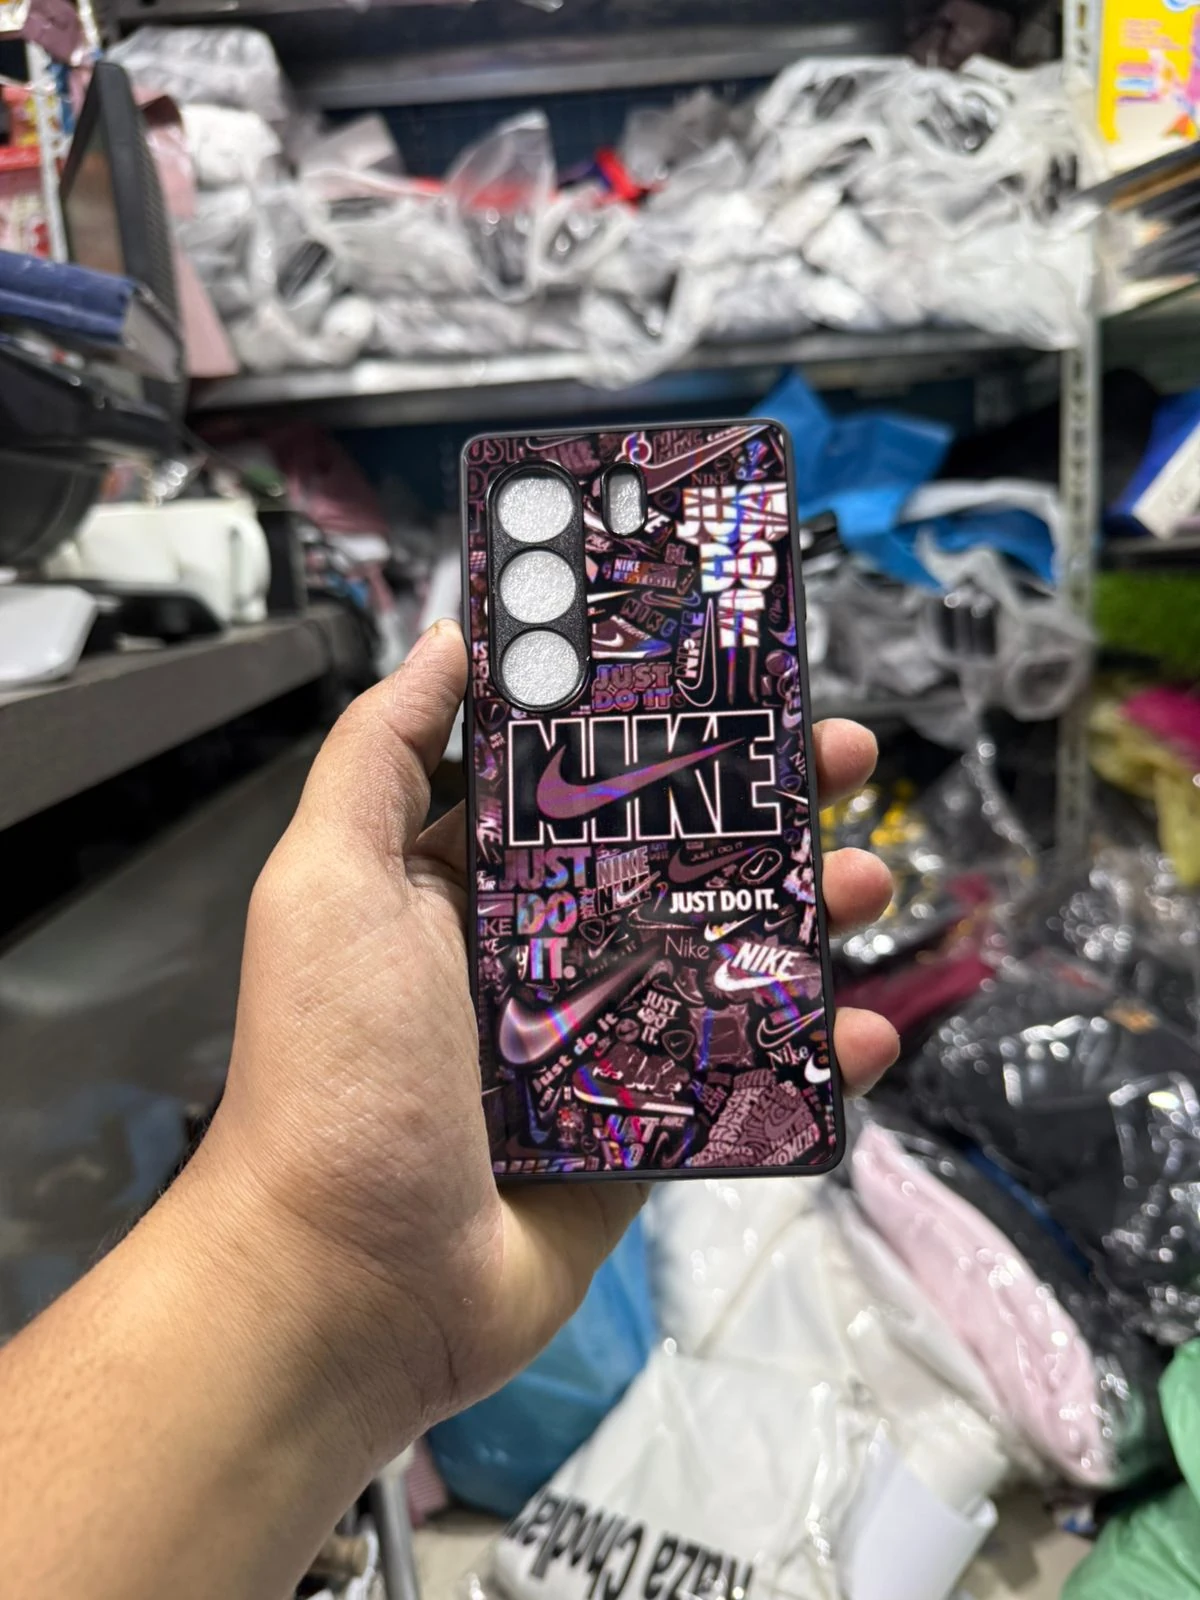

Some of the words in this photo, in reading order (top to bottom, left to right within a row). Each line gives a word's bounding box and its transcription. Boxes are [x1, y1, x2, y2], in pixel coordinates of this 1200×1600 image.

[691, 472, 730, 486] NIKE
[592, 662, 673, 694] JUST
[591, 688, 639, 712] DO
[643, 686, 673, 711] IT
[507, 709, 783, 847] NIKE
[500, 847, 591, 891] JUST
[516, 890, 578, 935] DO
[669, 890, 717, 914] JUST
[720, 888, 753, 912] DO
[754, 888, 780, 911] IT.
[530, 936, 577, 980] IT.
[664, 934, 710, 960] Nike
[730, 941, 801, 977] NIKE
[642, 989, 682, 1017] JUST
[573, 1031, 598, 1056] do
[640, 1026, 660, 1046] IT.
[766, 1041, 809, 1073] Nike
